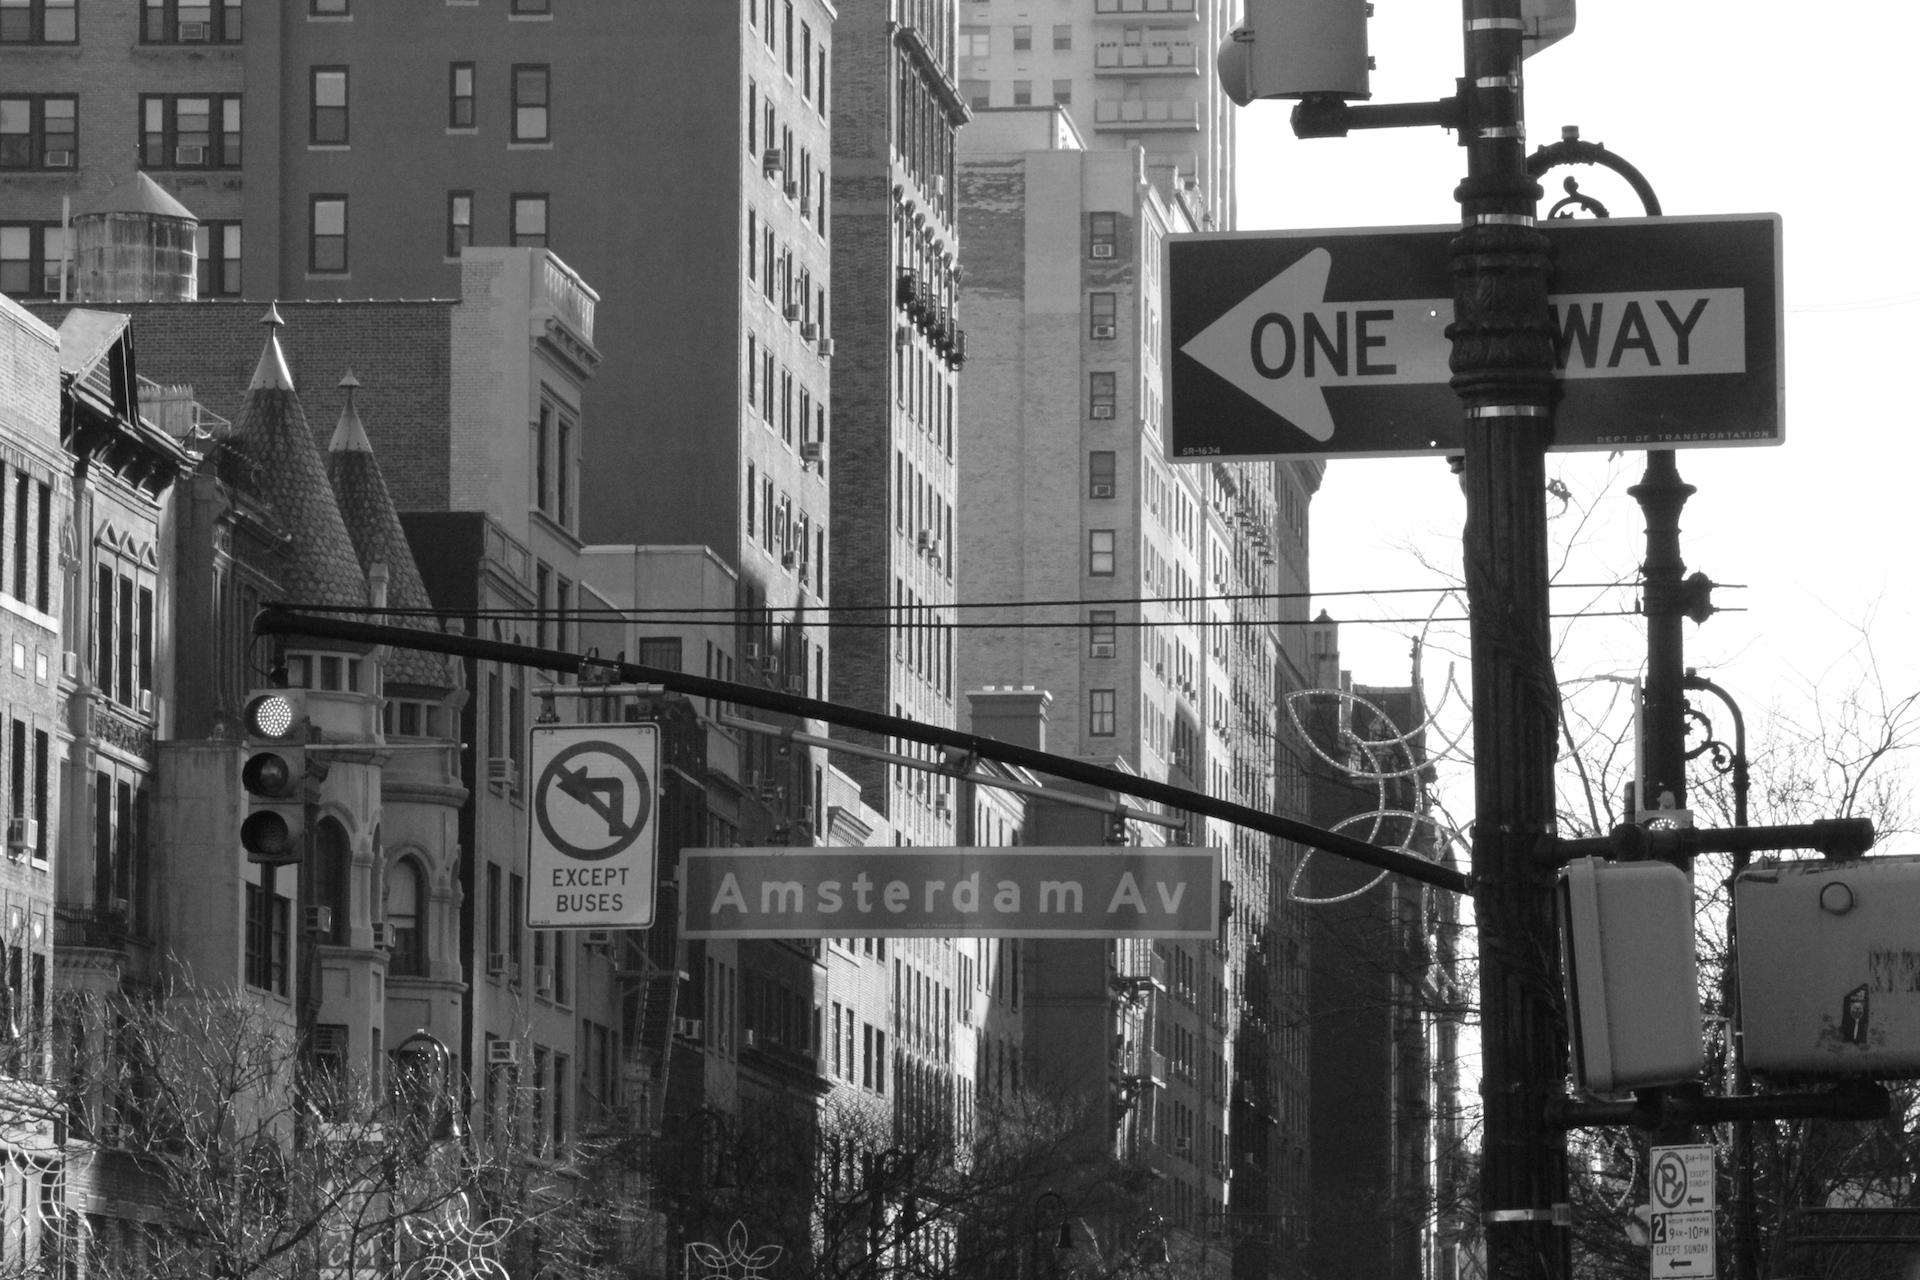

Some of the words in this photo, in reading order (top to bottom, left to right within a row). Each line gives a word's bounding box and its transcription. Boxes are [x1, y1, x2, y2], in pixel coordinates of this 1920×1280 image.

[1250, 309, 1397, 380] ONE
[1547, 298, 1711, 369] WAY
[1597, 435, 1628, 443] DEPT
[1657, 430, 1770, 441] TRANSPORTATION
[1182, 446, 1221, 456] SR-1634
[552, 867, 630, 887] EXCEPT
[710, 871, 1083, 914] Amsterdam
[1107, 871, 1187, 914] Av
[556, 893, 624, 913] BUSES
[1684, 1153, 1710, 1164] 8AM-9AM
[1689, 1170, 1709, 1178] EXCEPT
[1688, 1180, 1710, 1188] SUNDAY
[1653, 1215, 1664, 1241] 2
[1656, 1245, 1680, 1256] EXCEPT
[1683, 1243, 1709, 1255] SUNDAY
